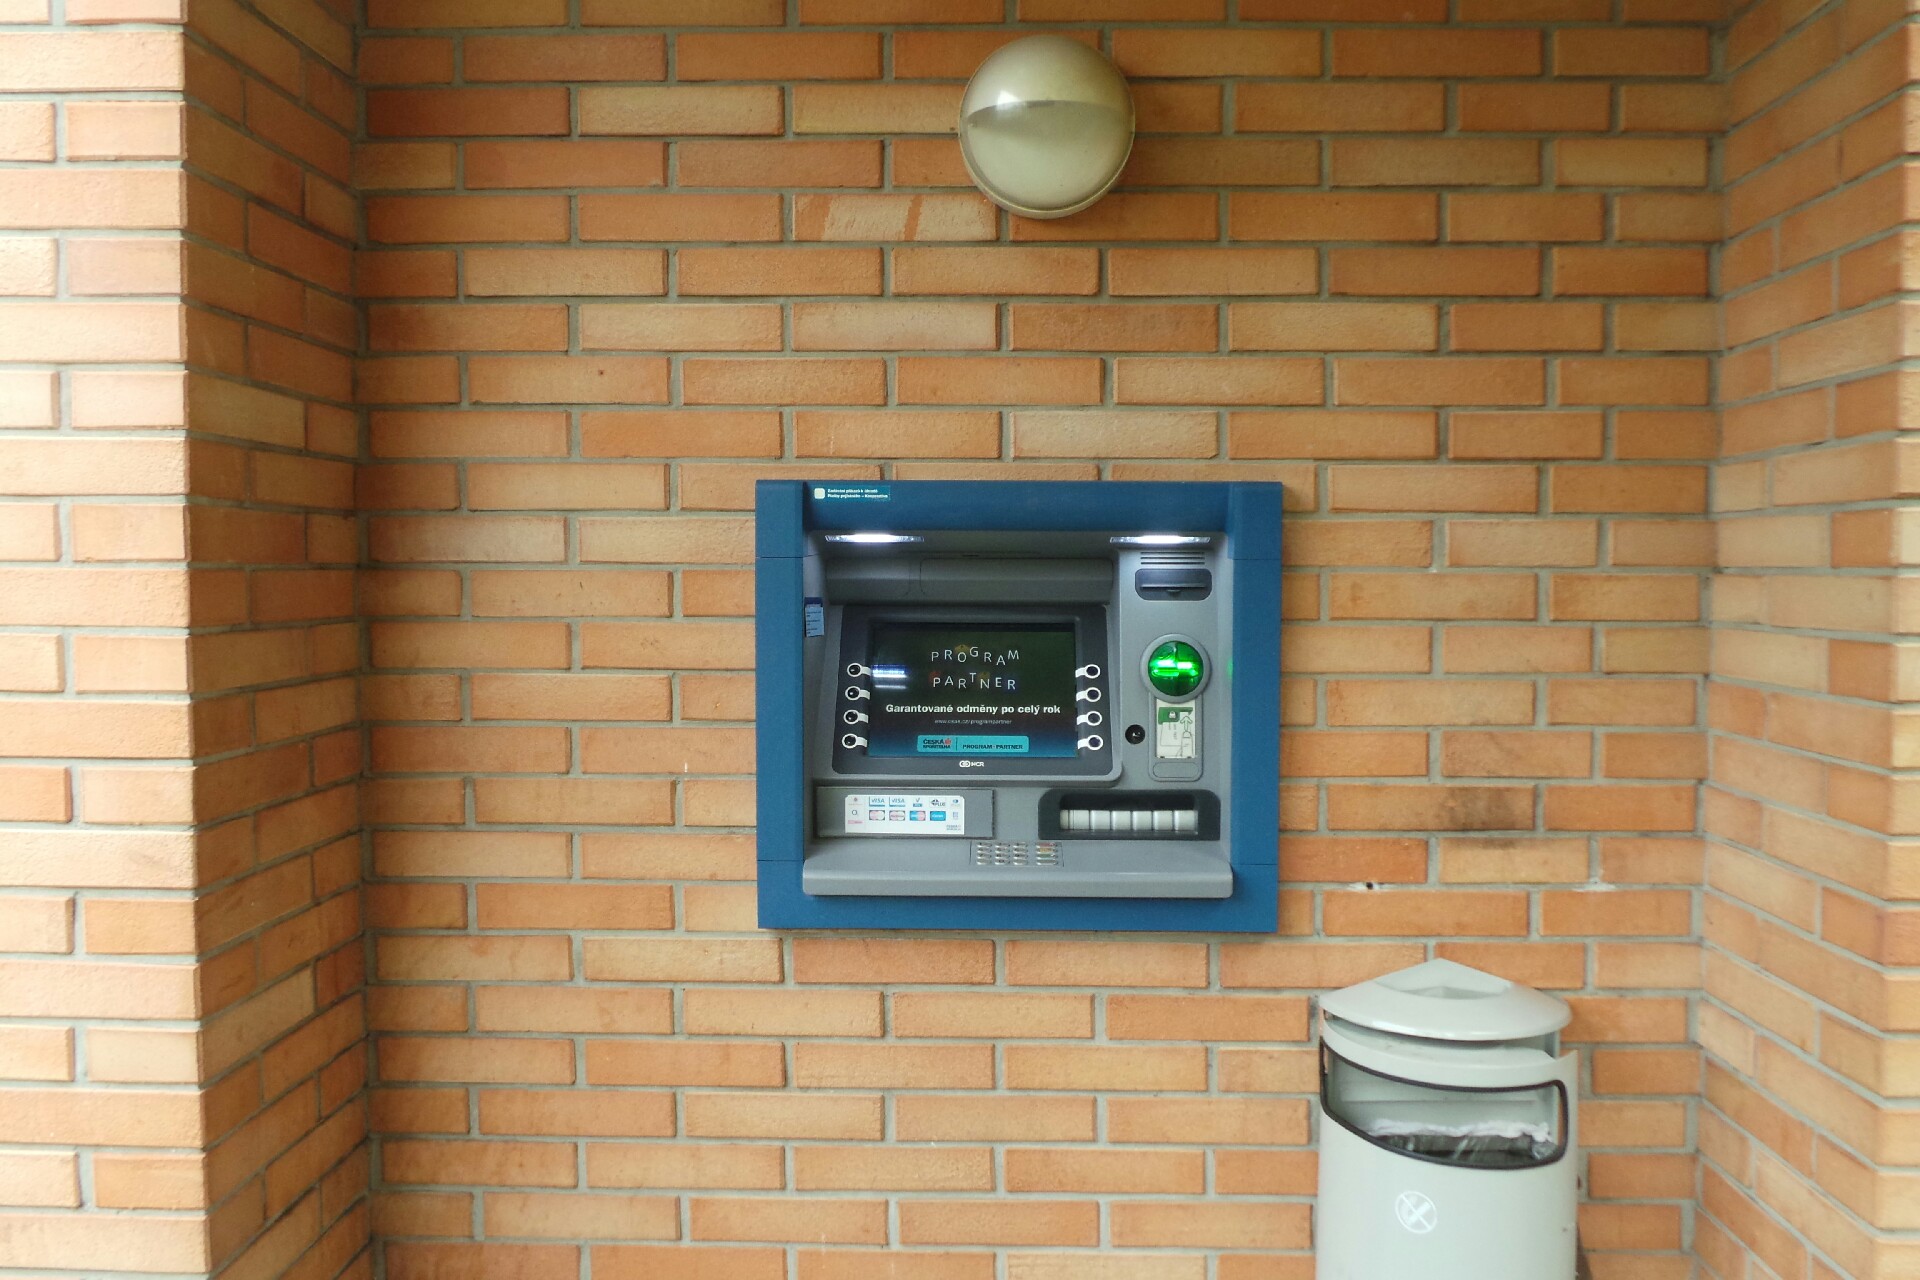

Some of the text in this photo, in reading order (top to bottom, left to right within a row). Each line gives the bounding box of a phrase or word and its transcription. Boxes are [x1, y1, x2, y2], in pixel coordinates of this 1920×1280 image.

[931, 646, 1020, 666] PROGRAM
[933, 672, 1016, 690] PARTNER
[886, 703, 1061, 715] Garantované odměny po celý rok
